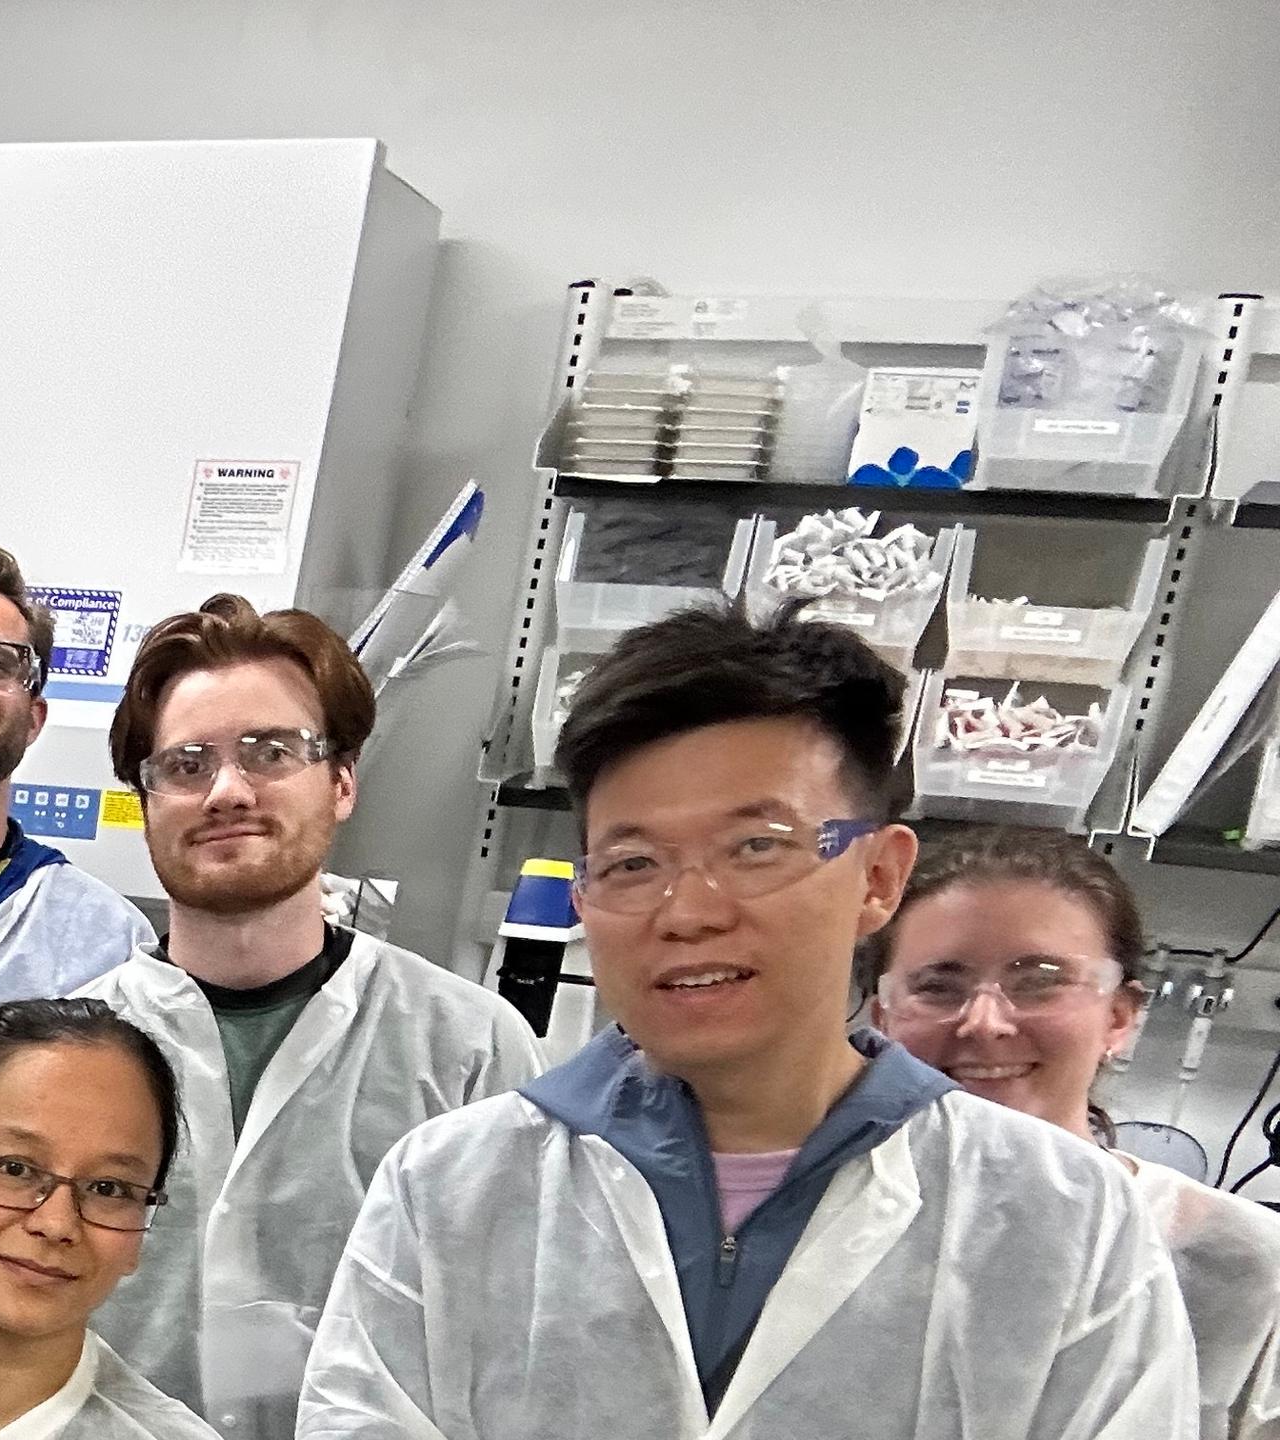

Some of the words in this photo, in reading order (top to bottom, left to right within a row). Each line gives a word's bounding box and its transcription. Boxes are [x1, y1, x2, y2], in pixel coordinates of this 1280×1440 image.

[218, 468, 274, 478] WARNING
[35, 597, 48, 606] of
[49, 597, 115, 610] Compliance
